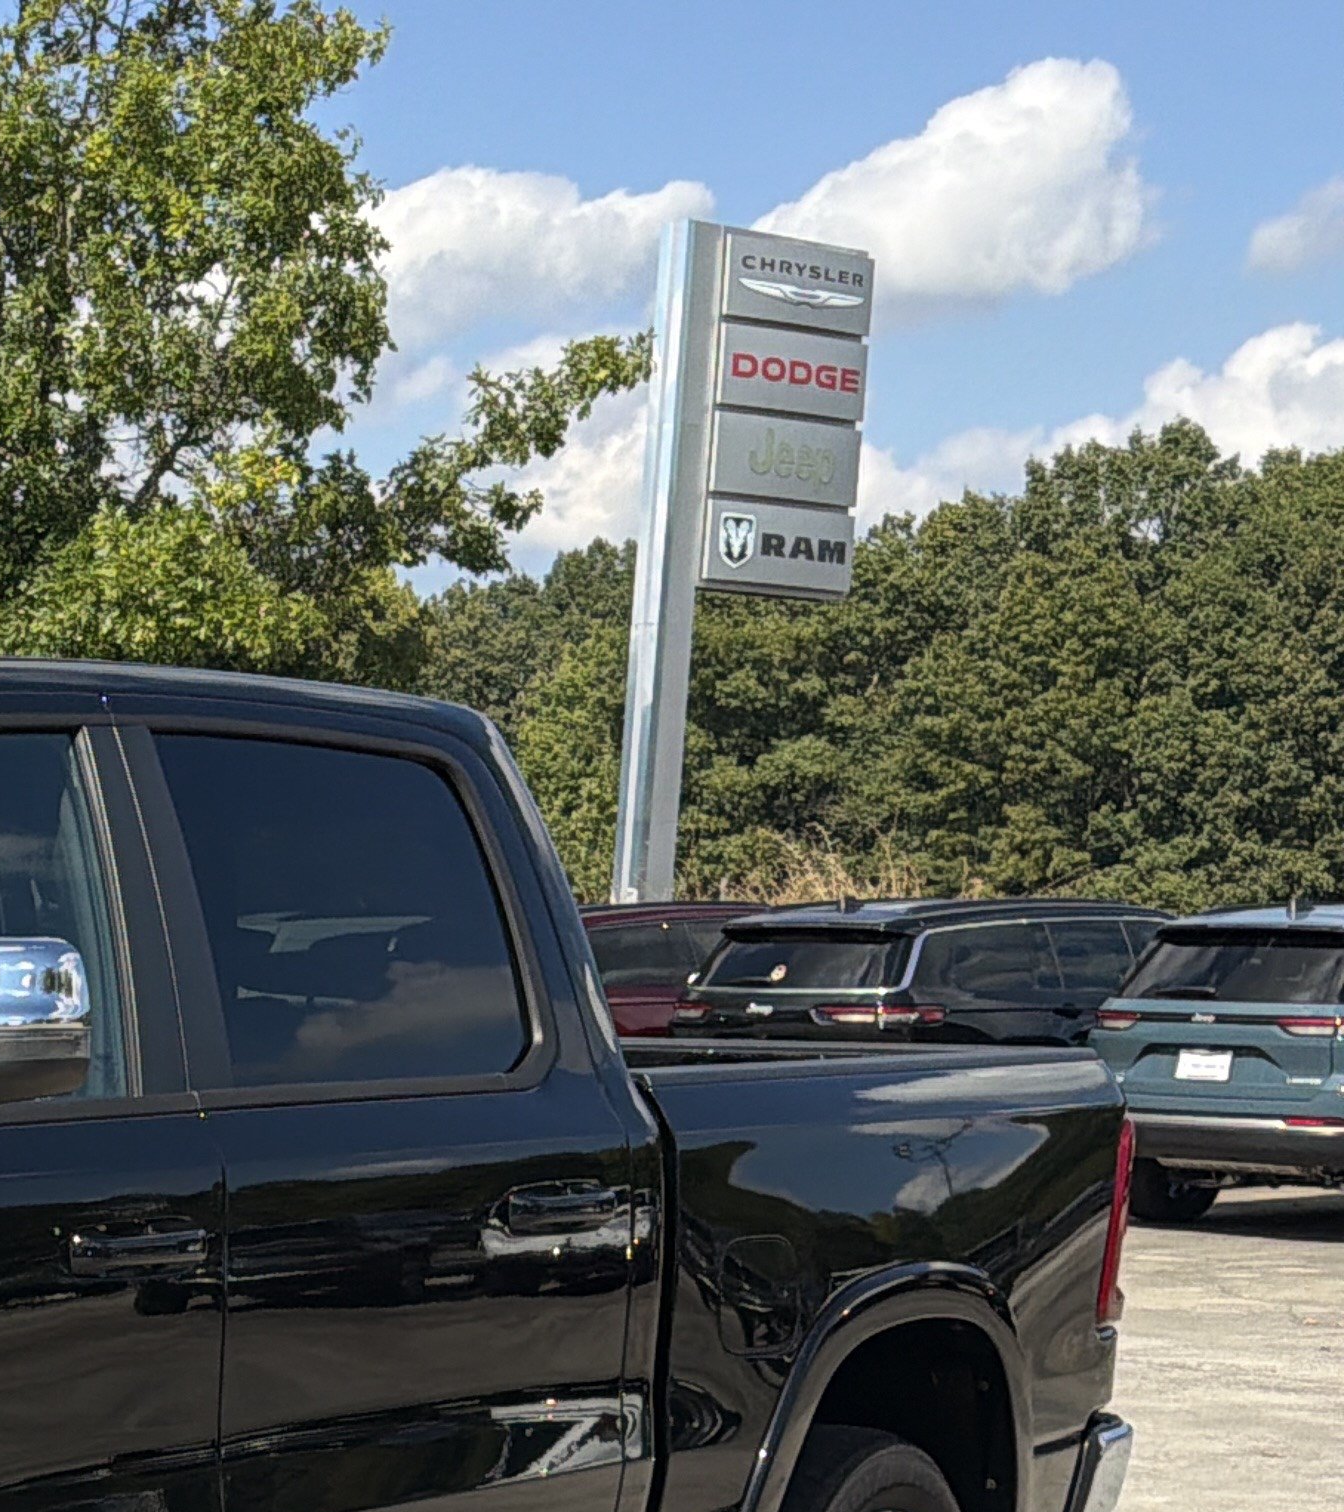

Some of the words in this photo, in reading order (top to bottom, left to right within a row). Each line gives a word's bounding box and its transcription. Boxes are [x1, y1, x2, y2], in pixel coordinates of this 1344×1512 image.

[742, 255, 864, 288] CHRYSLER
[732, 353, 862, 394] DODGE
[749, 427, 836, 487] Jeep
[761, 532, 847, 566] RAM
